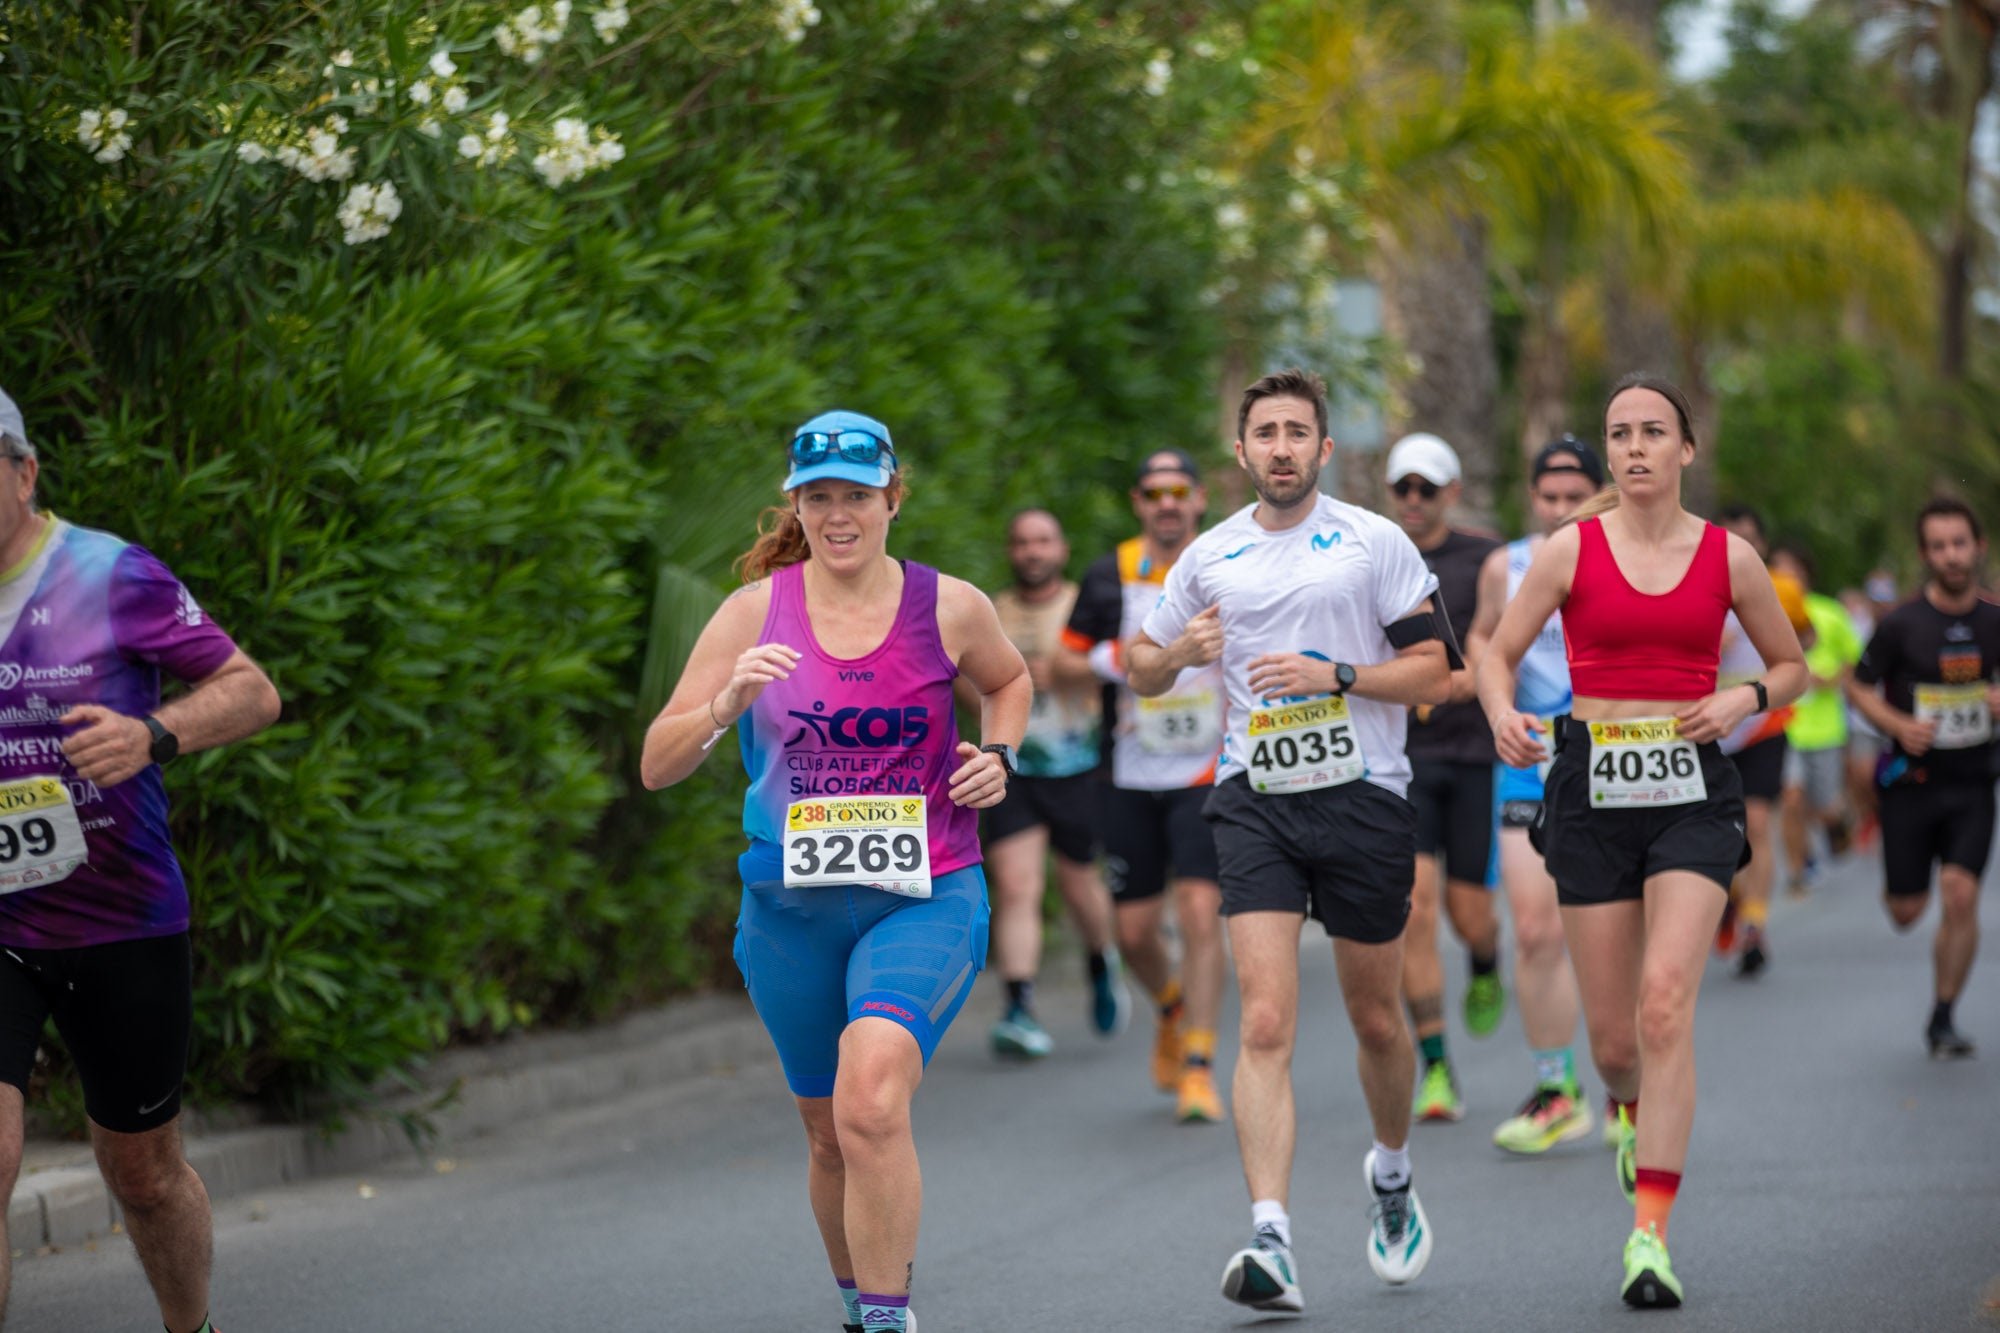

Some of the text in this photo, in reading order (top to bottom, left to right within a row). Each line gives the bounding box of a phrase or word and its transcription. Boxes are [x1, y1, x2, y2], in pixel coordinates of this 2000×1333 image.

[24, 664, 93, 681] Arrebola
[838, 670, 875, 682] vive
[829, 705, 929, 748] cas
[1251, 725, 1355, 772] 4035
[787, 756, 925, 773] CLUB ATLETISMO
[1593, 747, 1695, 783] 4036
[790, 770, 921, 796] SALOBREÑA
[804, 805, 826, 822] 38
[826, 807, 898, 823] FONDO
[857, 801, 890, 809] PREMIO
[790, 834, 922, 876] 3269
